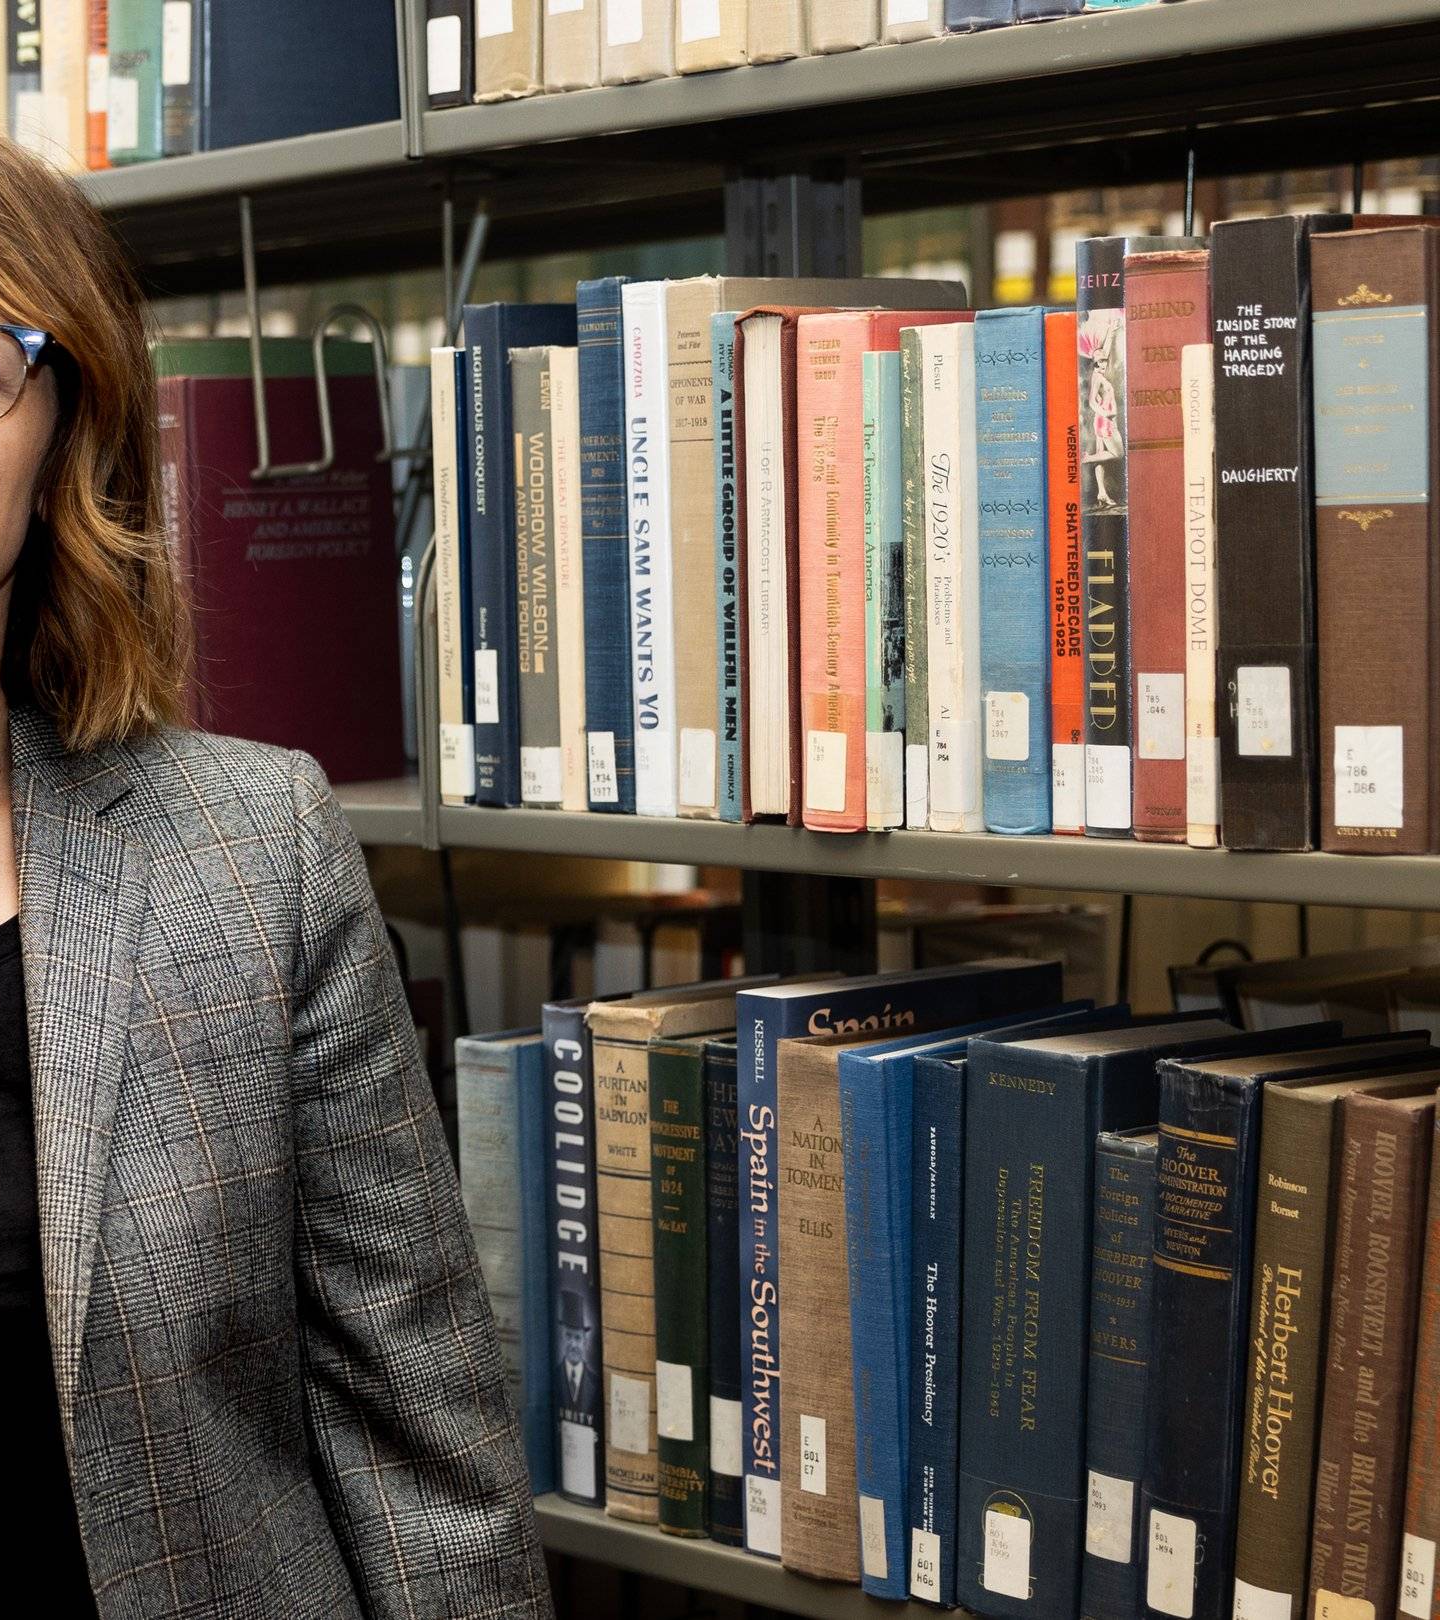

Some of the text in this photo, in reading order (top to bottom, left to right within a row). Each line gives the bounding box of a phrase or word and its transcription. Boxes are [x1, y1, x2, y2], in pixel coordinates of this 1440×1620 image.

[1079, 272, 1121, 289] ZEITZ
[1130, 301, 1196, 321] BEHIND
[1237, 304, 1262, 317] THE
[1216, 317, 1297, 332] INSIDE STORY
[1224, 334, 1268, 347] OF THE
[632, 327, 643, 400] CAPOZZOLA
[1143, 346, 1176, 364] THE
[1224, 347, 1283, 362] HARDING
[934, 353, 944, 391] Plesur
[1222, 363, 1285, 377] TRAGEDY
[540, 370, 551, 411] LEVIN
[674, 394, 707, 406] OF WAR
[1190, 378, 1200, 434] NOGGLE
[472, 345, 486, 515] RIGHTEOUS CONQUEST
[814, 416, 825, 437] The
[864, 418, 876, 446] The
[630, 417, 651, 507] UNCLE
[762, 457, 771, 475] OF
[1066, 425, 1077, 484] WERSTEIN
[826, 463, 840, 486] and
[864, 452, 876, 517] Twenties
[1221, 466, 1299, 484] DAUGHERTY
[439, 466, 449, 531] Woodrow
[931, 452, 951, 567] The 1920's
[557, 438, 571, 591] THE GREAT DEPARTURE
[825, 487, 841, 549] Continuity
[761, 496, 771, 576] ARMACOST
[865, 521, 872, 536] in
[528, 432, 549, 652] WOODROW WILSON
[633, 518, 652, 576] SAM
[720, 388, 737, 742] A LITTLE GROUP OF WILLFUL MEN
[826, 550, 839, 566] in
[1189, 476, 1207, 651] TEAPOT DOME
[516, 490, 531, 674] AND WORLD POLITICS
[865, 541, 874, 602] America
[1065, 502, 1081, 658] SHATTERED DECADE
[933, 576, 942, 626] Paradoxes
[943, 576, 953, 646] Problems and
[443, 591, 453, 643] Western
[826, 571, 842, 678] Twentieth-Century
[635, 587, 655, 683] WANTS
[1086, 549, 1117, 730] FLAPPER
[444, 646, 453, 679] Tour
[1145, 695, 1160, 703] 785
[1146, 705, 1166, 715] .G46
[638, 693, 659, 731] YO
[936, 742, 947, 750] 784
[727, 754, 735, 802] KENNIKAT
[1345, 765, 1368, 777] 786
[1347, 782, 1376, 794] .D86
[1361, 827, 1397, 838] STATE
[808, 1003, 915, 1036] Spain
[753, 1019, 765, 1083] KESSELL
[616, 1061, 624, 1074] A
[598, 1075, 648, 1093] PURITAN
[987, 1071, 1057, 1096] KENNEDY
[615, 1095, 627, 1106] IN
[662, 1099, 680, 1115] THE
[598, 1109, 648, 1125] BABYLON
[813, 1115, 823, 1132] A
[607, 1144, 637, 1158] WHITE
[792, 1130, 844, 1154] NATION
[553, 1038, 588, 1275] COOLIDGE
[809, 1153, 825, 1170] IN
[1176, 1146, 1198, 1162] The
[785, 1167, 844, 1192] TORMEN
[1109, 1167, 1129, 1182] The
[1161, 1157, 1221, 1183] HOOVER
[661, 1180, 683, 1196] 1924
[1268, 1173, 1308, 1195] Robinson
[1100, 1186, 1141, 1207] Foreign
[1166, 1193, 1223, 1213] DOCUMENTED
[1098, 1207, 1139, 1226] Policies
[1163, 1202, 1212, 1221] NARRATIVE
[1270, 1201, 1300, 1219] Bornet
[798, 1218, 834, 1239] ELLIS
[1110, 1232, 1122, 1243] of
[1164, 1226, 1208, 1246] MYERS and
[1165, 1240, 1202, 1257] NEWTON
[1331, 1138, 1361, 1372] From Depression to New Deal
[995, 1256, 1005, 1287] and
[740, 1103, 781, 1474] Spain in the Southwest
[1005, 1199, 1022, 1387] The American People in
[1020, 1163, 1044, 1431] FREEDOM FROM FEAR
[922, 1262, 939, 1427] The Hoover Presidency
[1247, 1263, 1273, 1485] President of the United States
[1341, 1130, 1397, 1598] HOOVER, ROOSEVELT, and the BRAINS TRUS
[1261, 1263, 1303, 1500] Herbert Hoover
[804, 1450, 820, 1463] 801
[804, 1464, 815, 1476] E7
[1319, 1459, 1341, 1513] Elliot
[1317, 1519, 1335, 1532] A.
[917, 1558, 934, 1572] 801
[1406, 1569, 1425, 1585] 801
